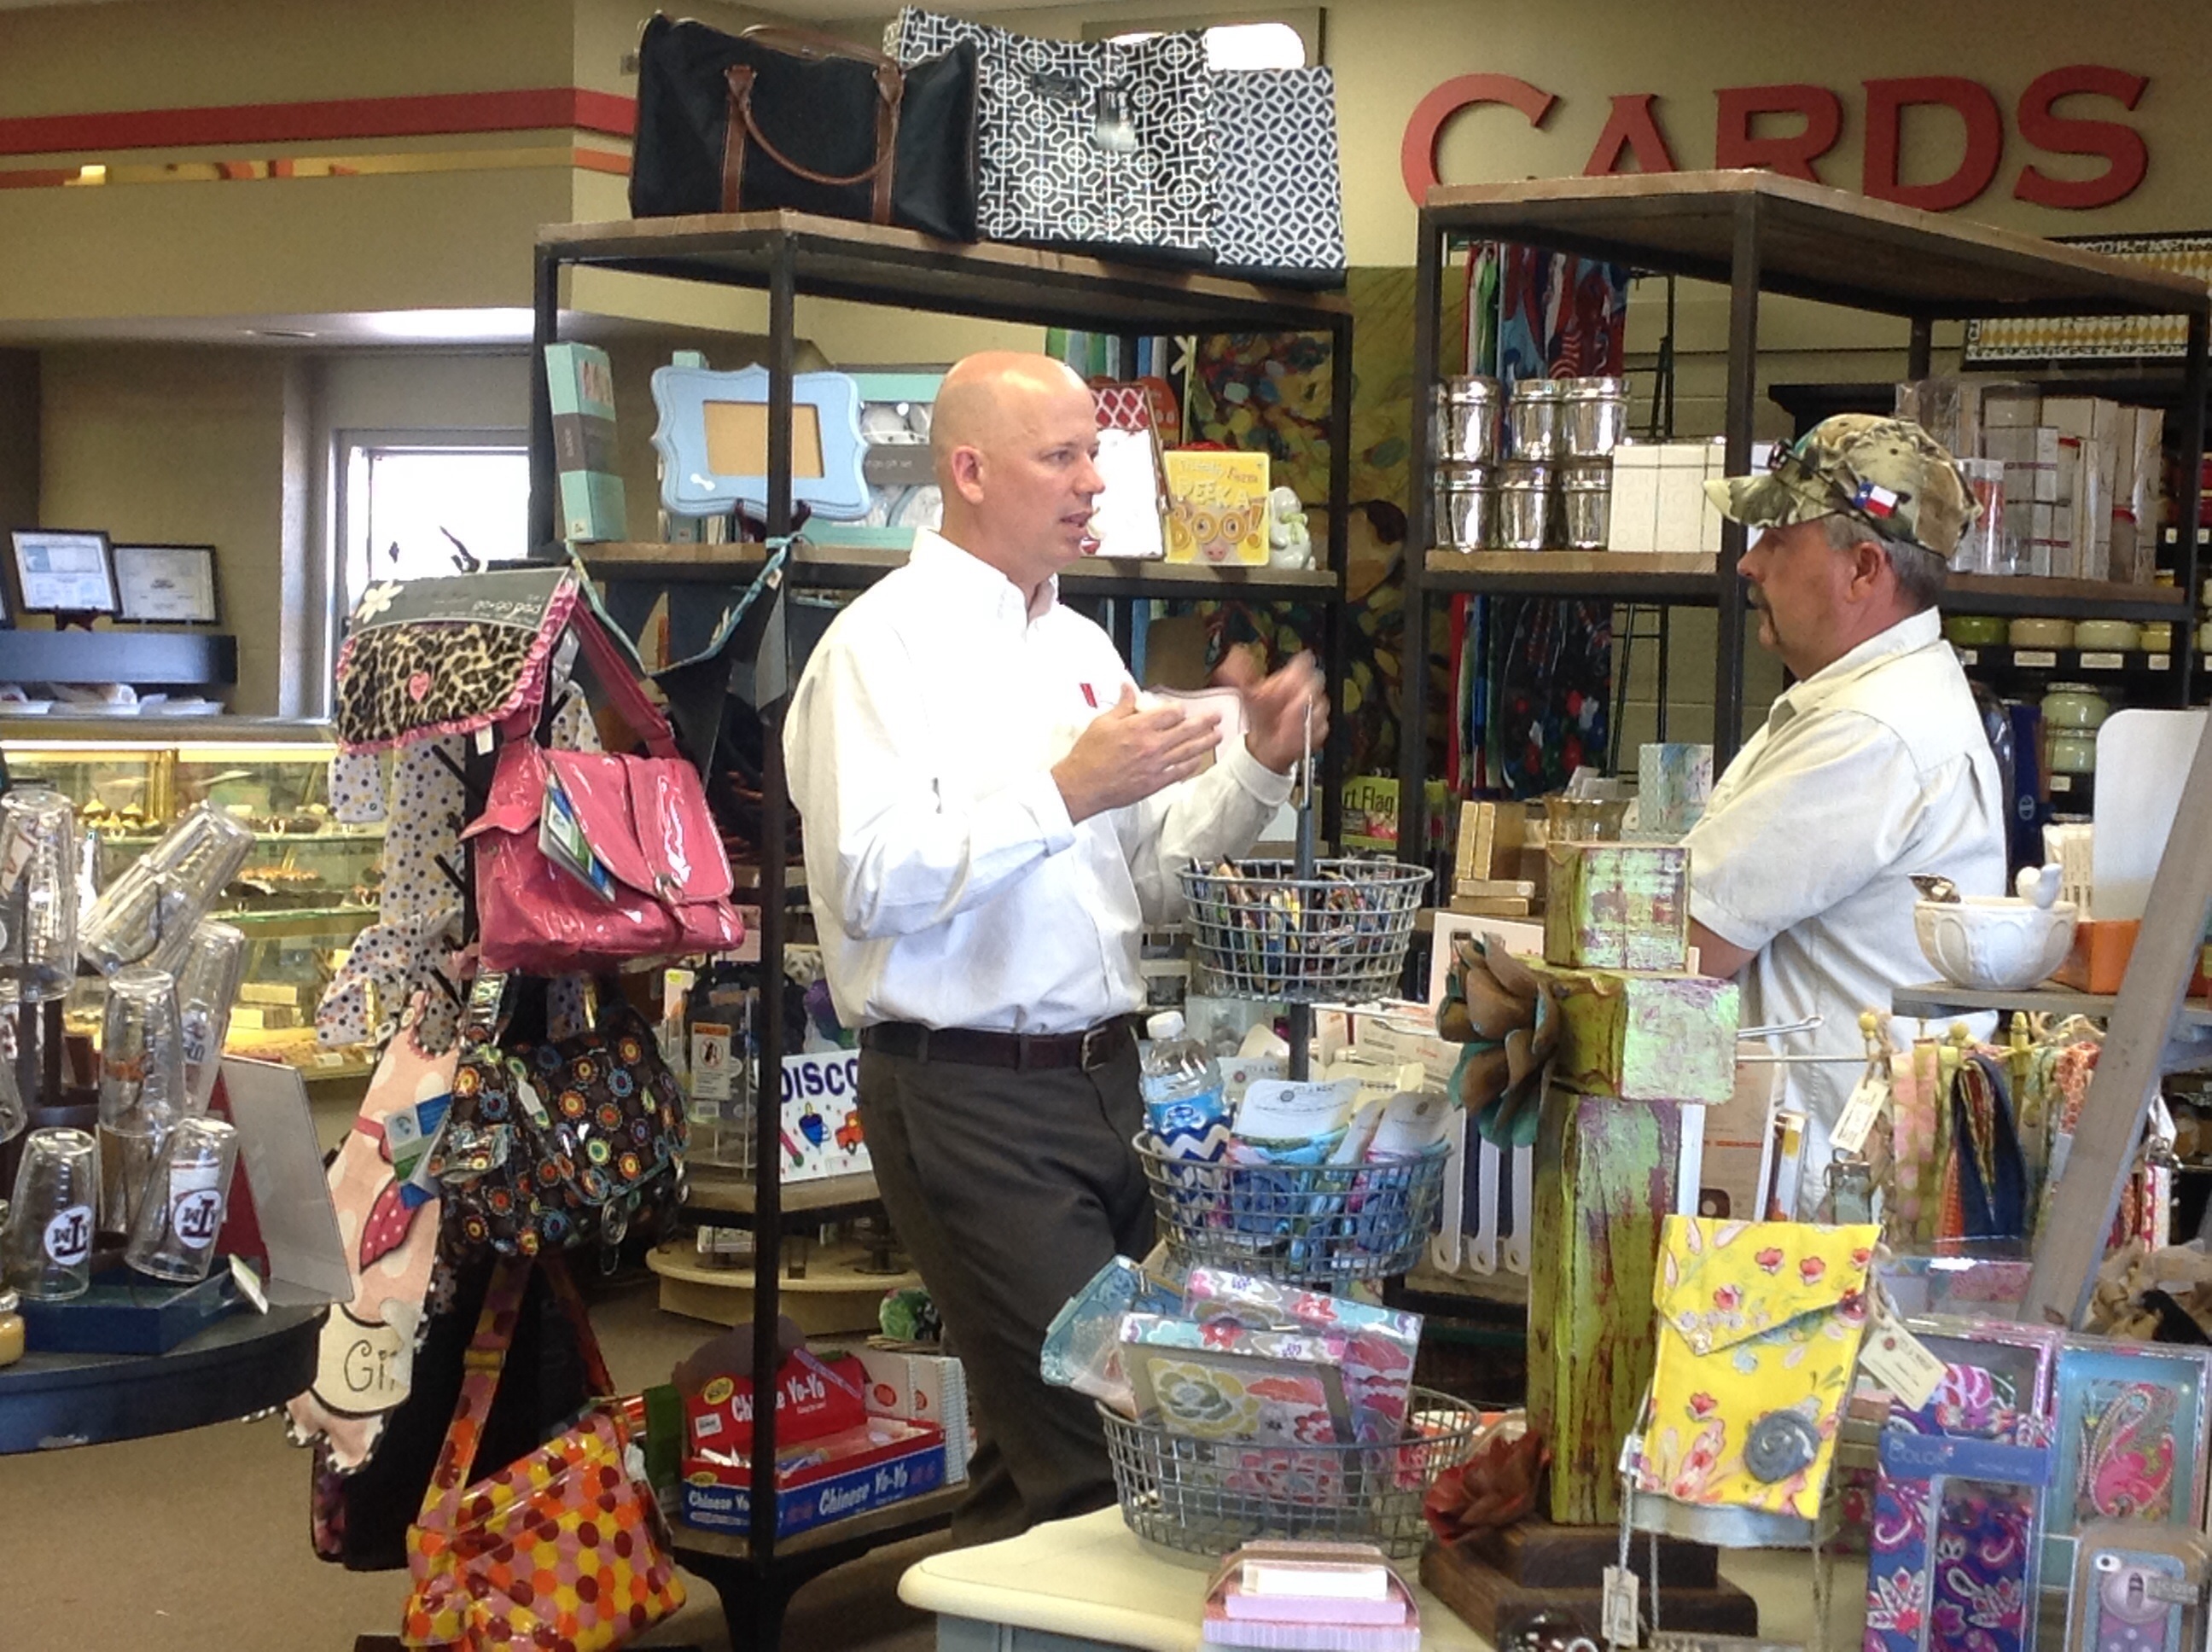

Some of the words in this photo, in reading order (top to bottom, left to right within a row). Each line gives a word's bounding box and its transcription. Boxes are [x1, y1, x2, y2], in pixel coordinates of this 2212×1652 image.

[1400, 65, 2151, 212] CARDS
[1169, 502, 1264, 551] BOO!
[1362, 785, 1394, 818] Flag
[787, 1375, 825, 1404] Yo-Yo
[689, 1490, 732, 1510] Chinese
[819, 1483, 870, 1515] Chinese
[876, 1463, 908, 1493] Yo-Yo
